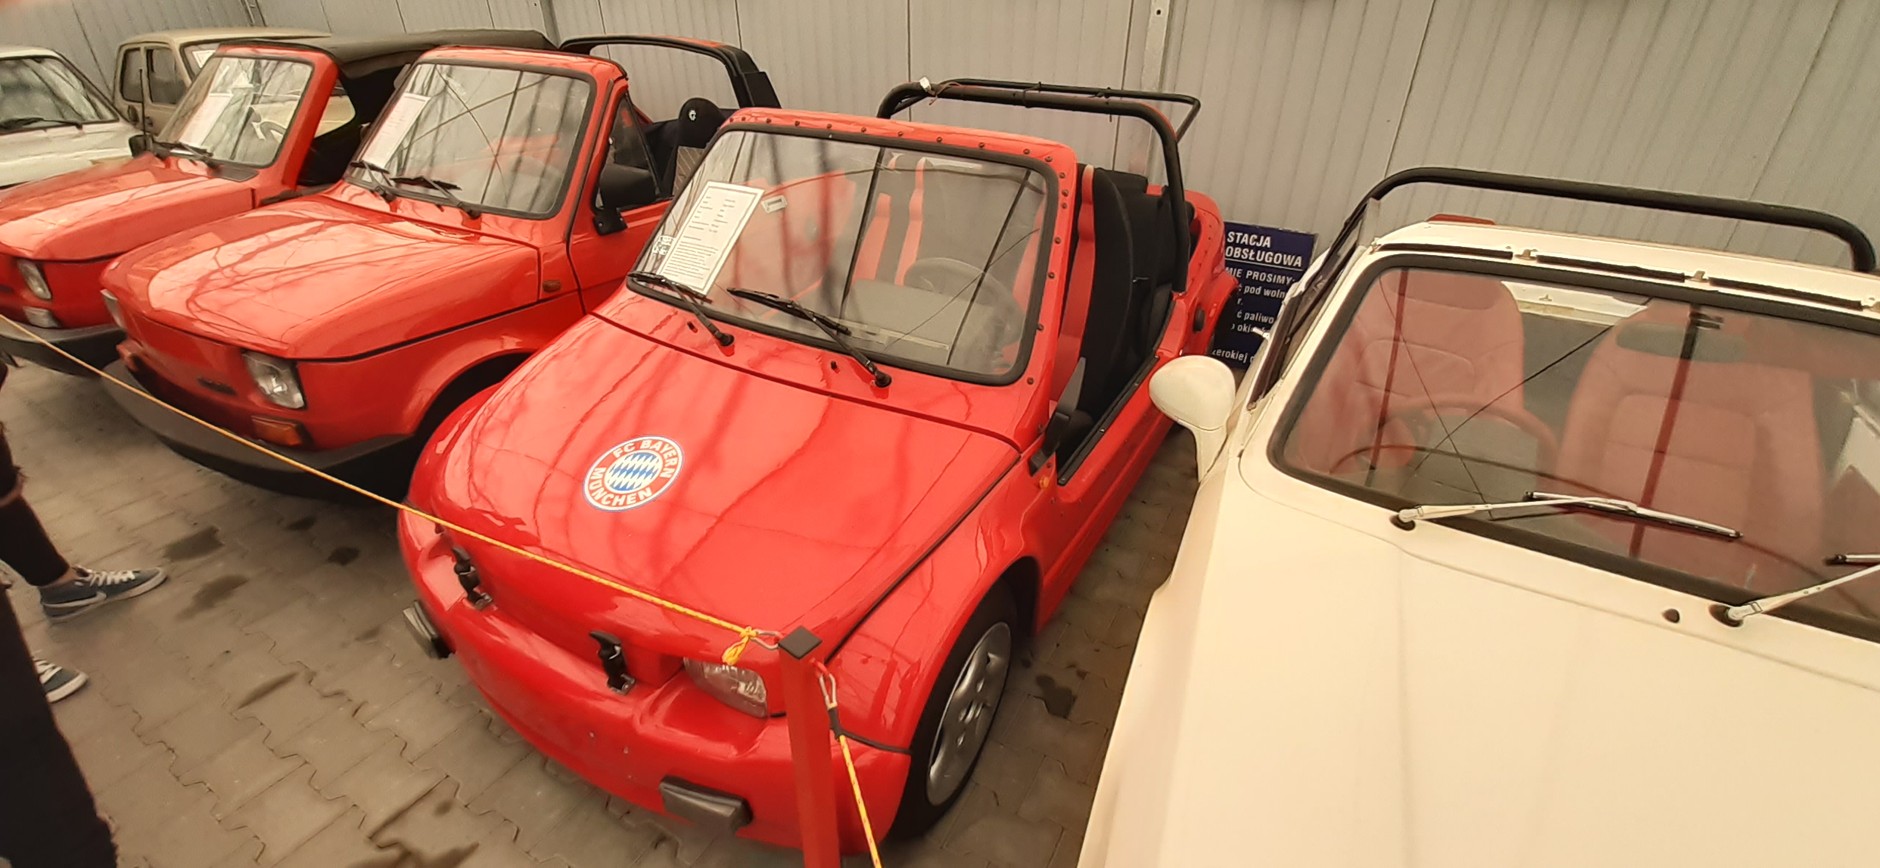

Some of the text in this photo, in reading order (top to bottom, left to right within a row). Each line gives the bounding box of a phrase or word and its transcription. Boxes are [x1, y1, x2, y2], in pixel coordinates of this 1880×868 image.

[1227, 231, 1271, 248] STACJA
[1225, 246, 1302, 267] OBSŁUGOWA
[1243, 285, 1262, 295] pod
[1263, 287, 1285, 298] woln
[1243, 312, 1274, 324] paliwo
[612, 439, 678, 479] FC BAYERN
